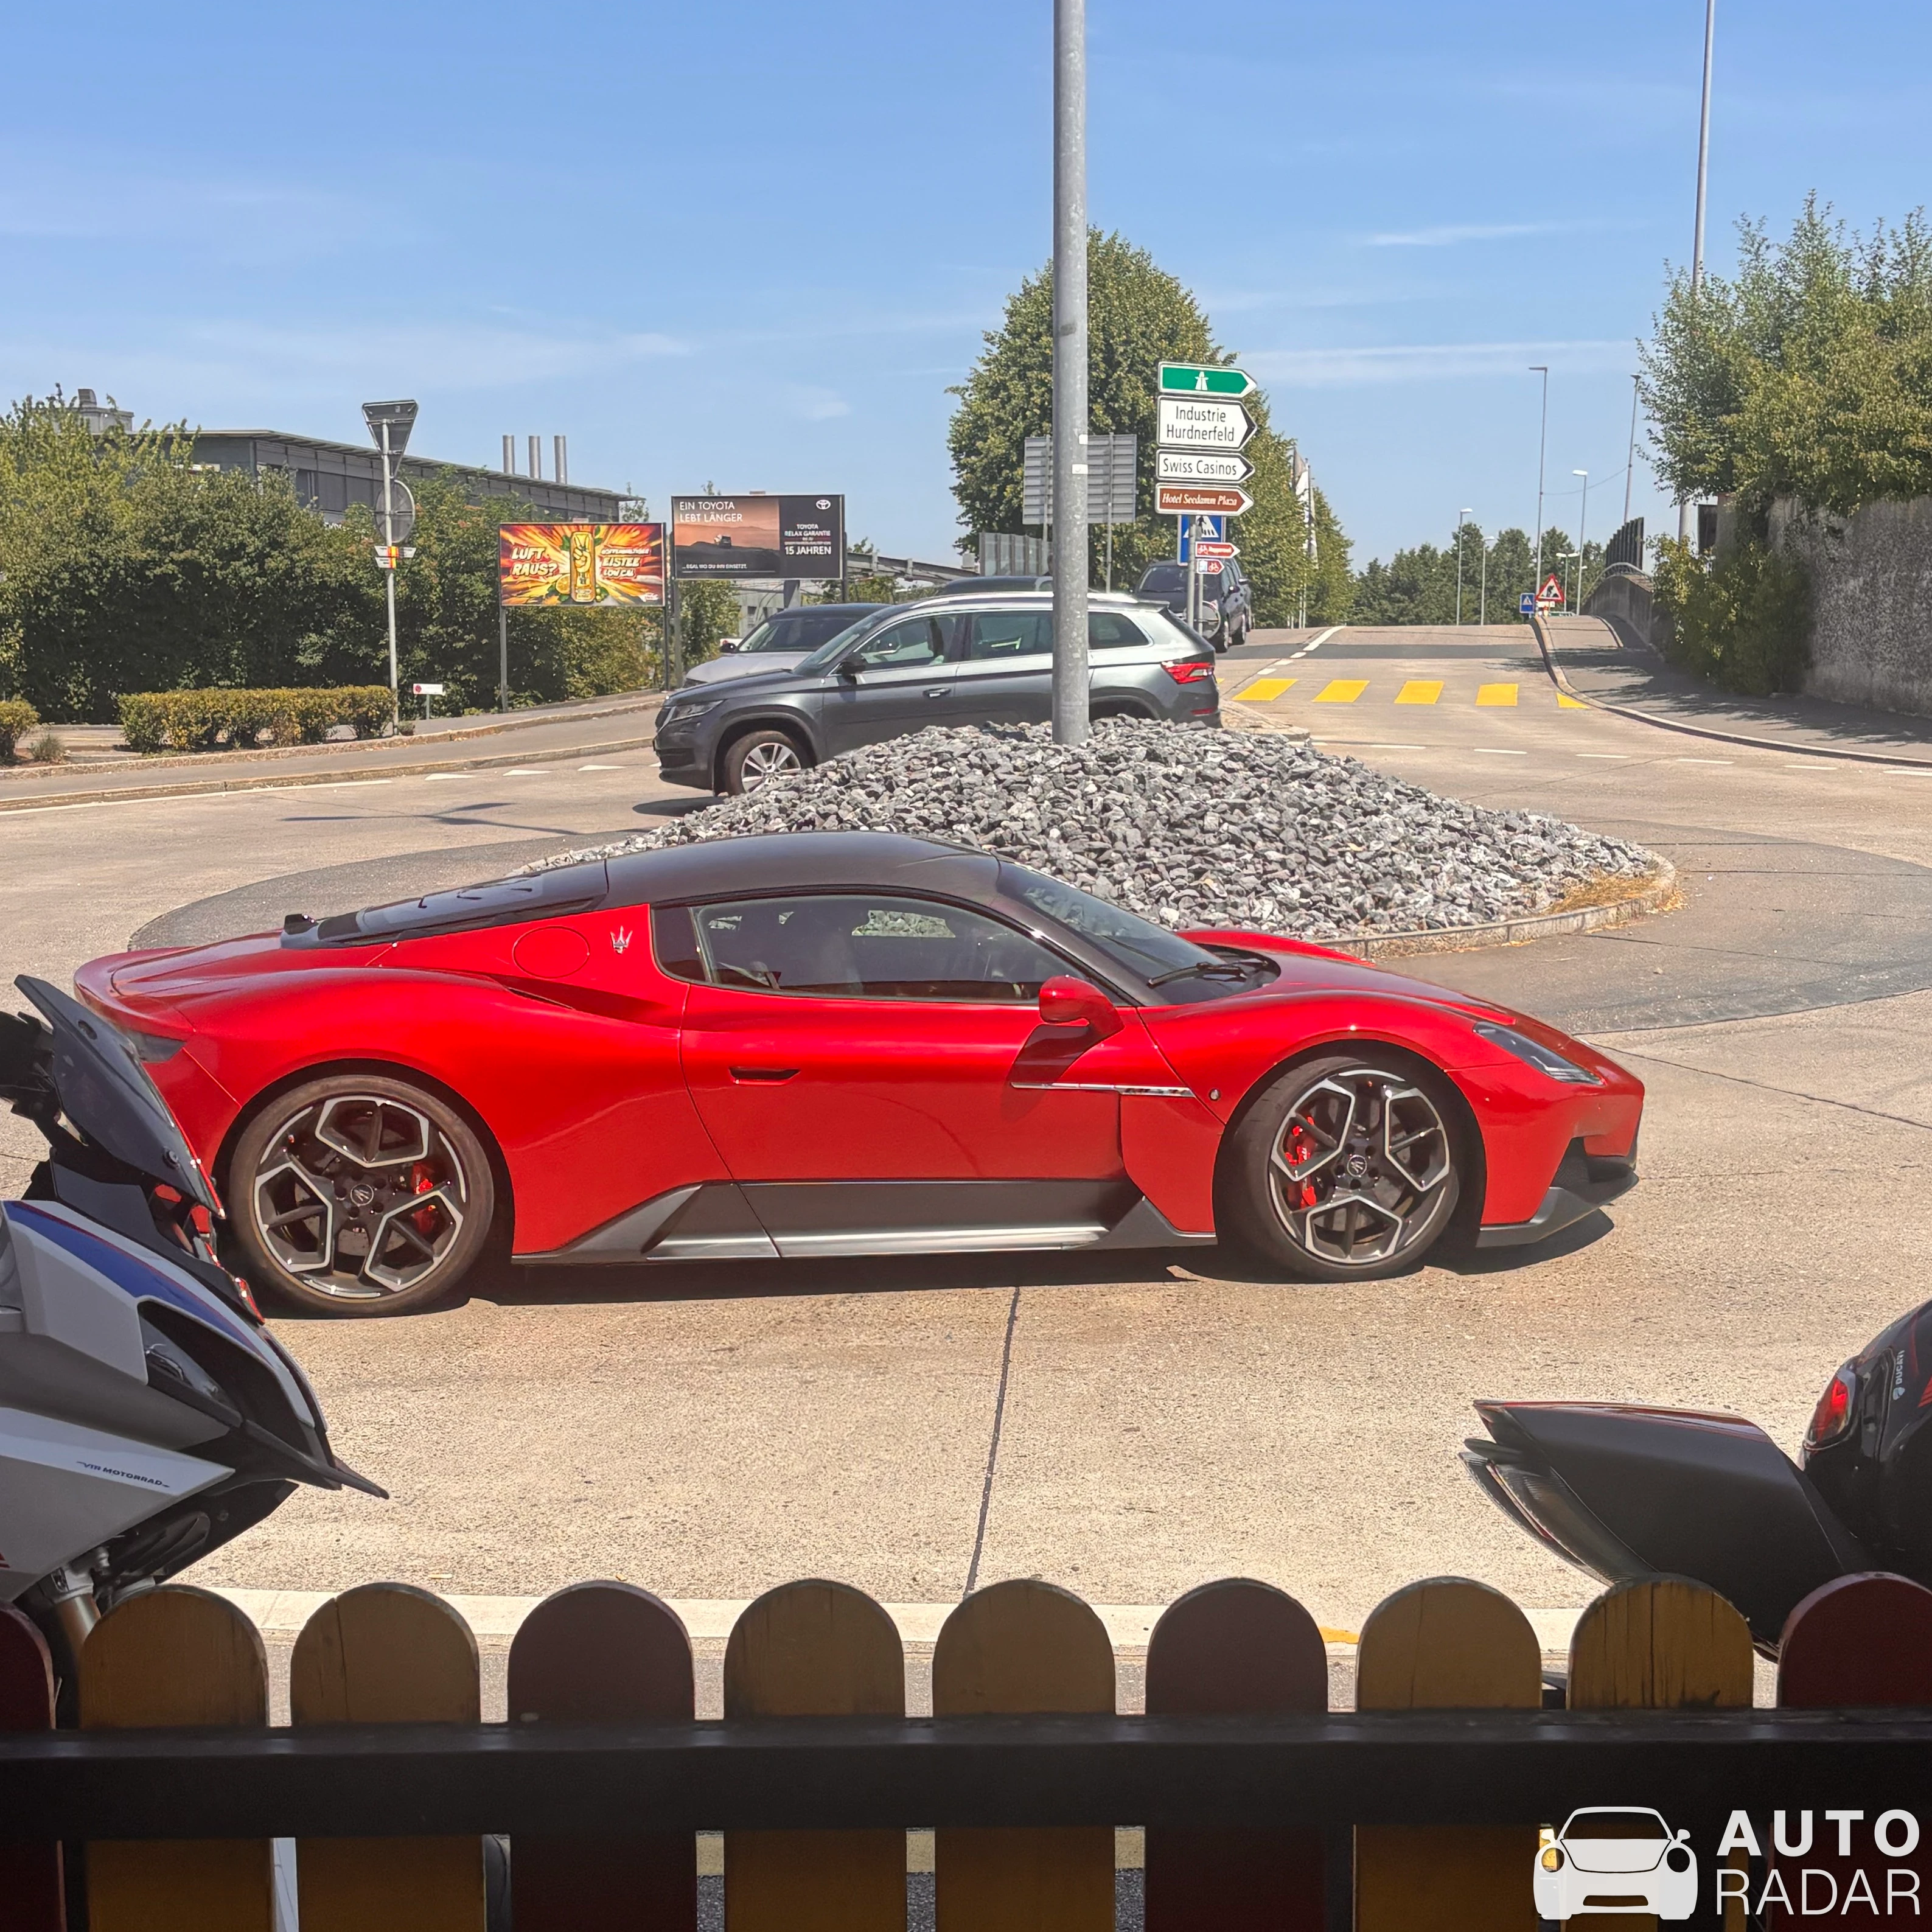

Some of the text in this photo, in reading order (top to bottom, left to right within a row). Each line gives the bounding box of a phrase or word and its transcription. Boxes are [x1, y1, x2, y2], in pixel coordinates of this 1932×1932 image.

[1175, 405, 1226, 422] Industrie
[1167, 424, 1235, 442] Hurdnerfeld
[1163, 458, 1237, 476] Swiss Casinos
[679, 501, 735, 511] EIN TOYOTA
[1162, 493, 1238, 506] Hotel Seedamm Plaza
[680, 511, 743, 523] LEBT LÄNGER
[511, 546, 545, 560] LUFT
[785, 546, 832, 555] 15 JAHREN
[602, 557, 641, 567] EISTEE
[512, 563, 558, 576] RAUS?
[1895, 1350, 1905, 1386] DUCATI
[102, 1466, 163, 1486] MOTORRAD
